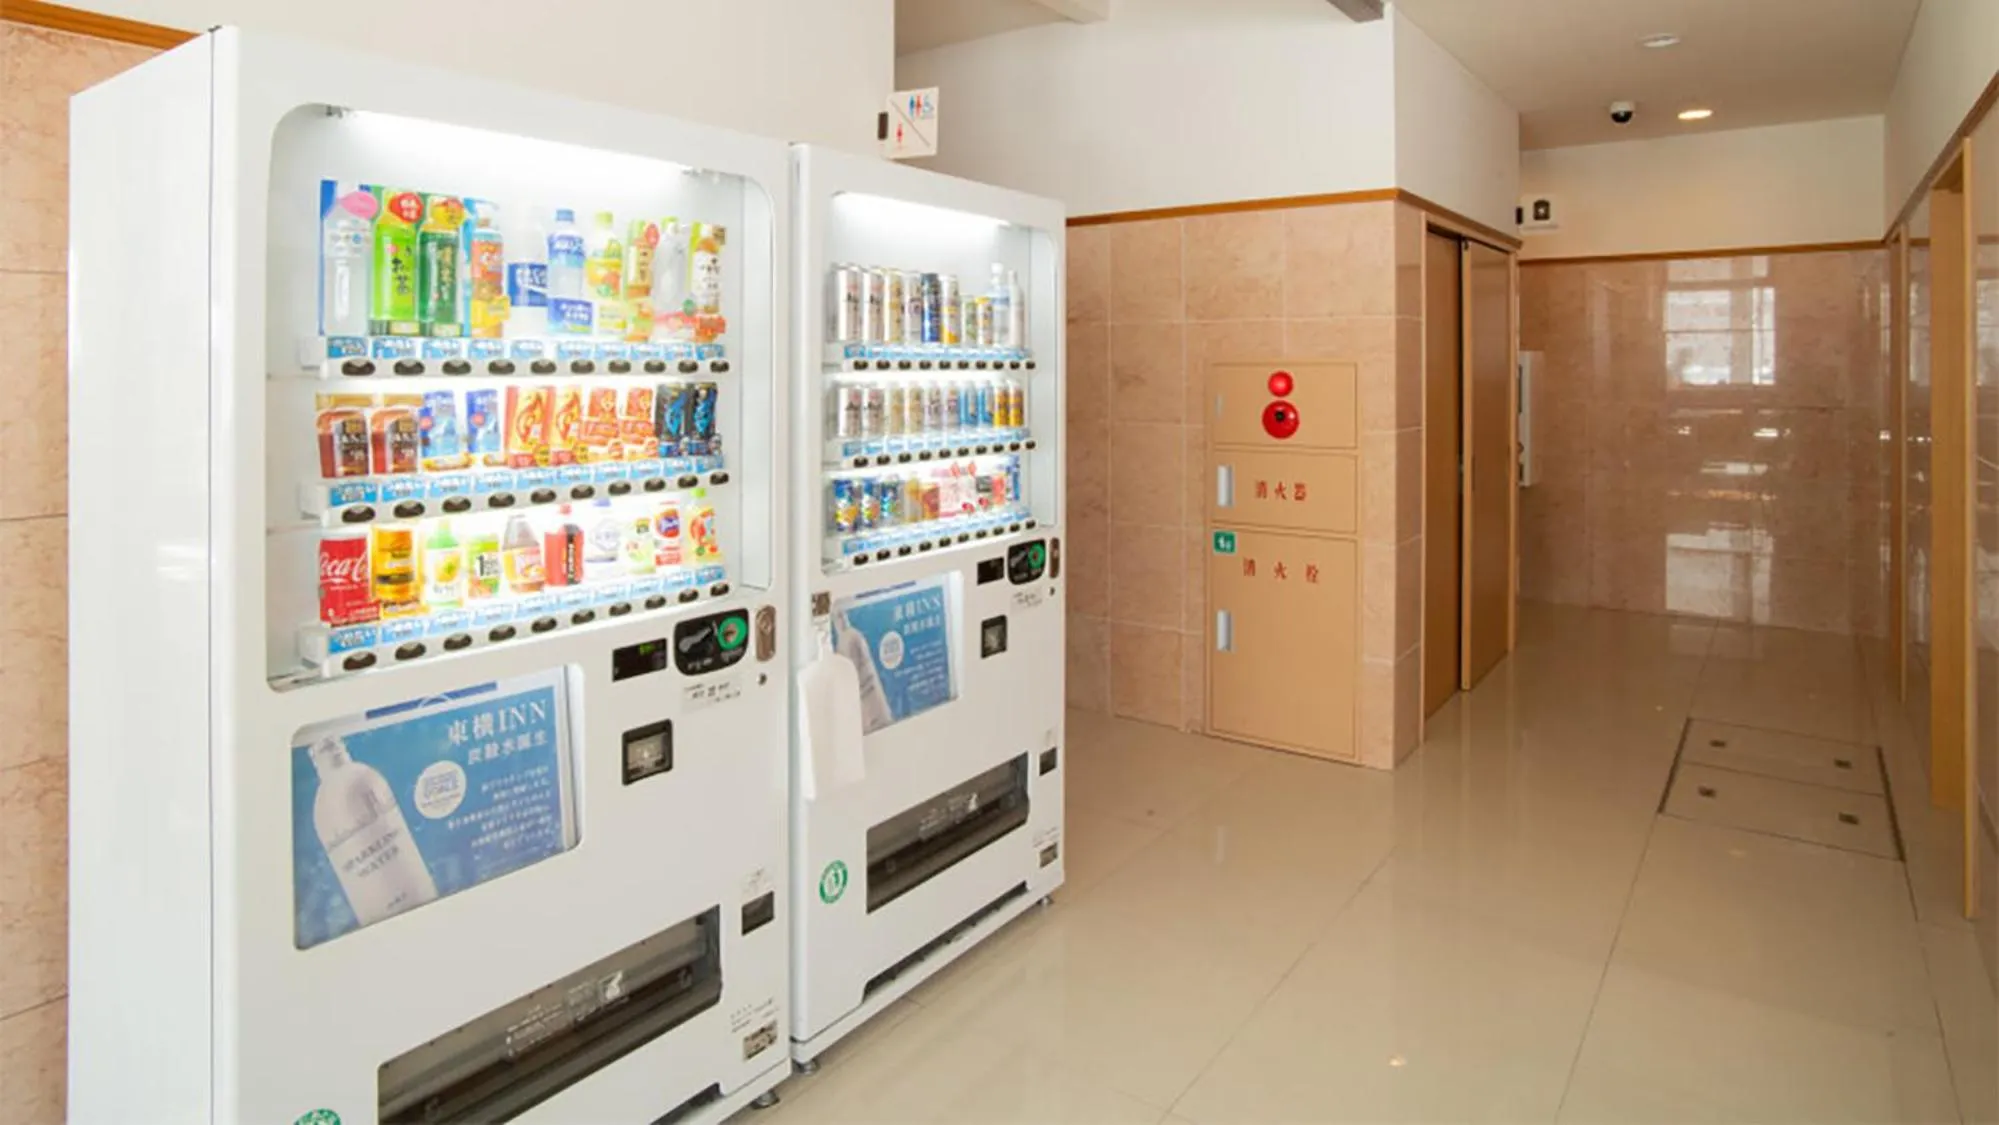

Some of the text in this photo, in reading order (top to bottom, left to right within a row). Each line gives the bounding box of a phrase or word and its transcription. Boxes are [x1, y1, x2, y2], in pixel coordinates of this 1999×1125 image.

[1255, 480, 1306, 501] 消火器
[1243, 557, 1319, 584] 消火栓
